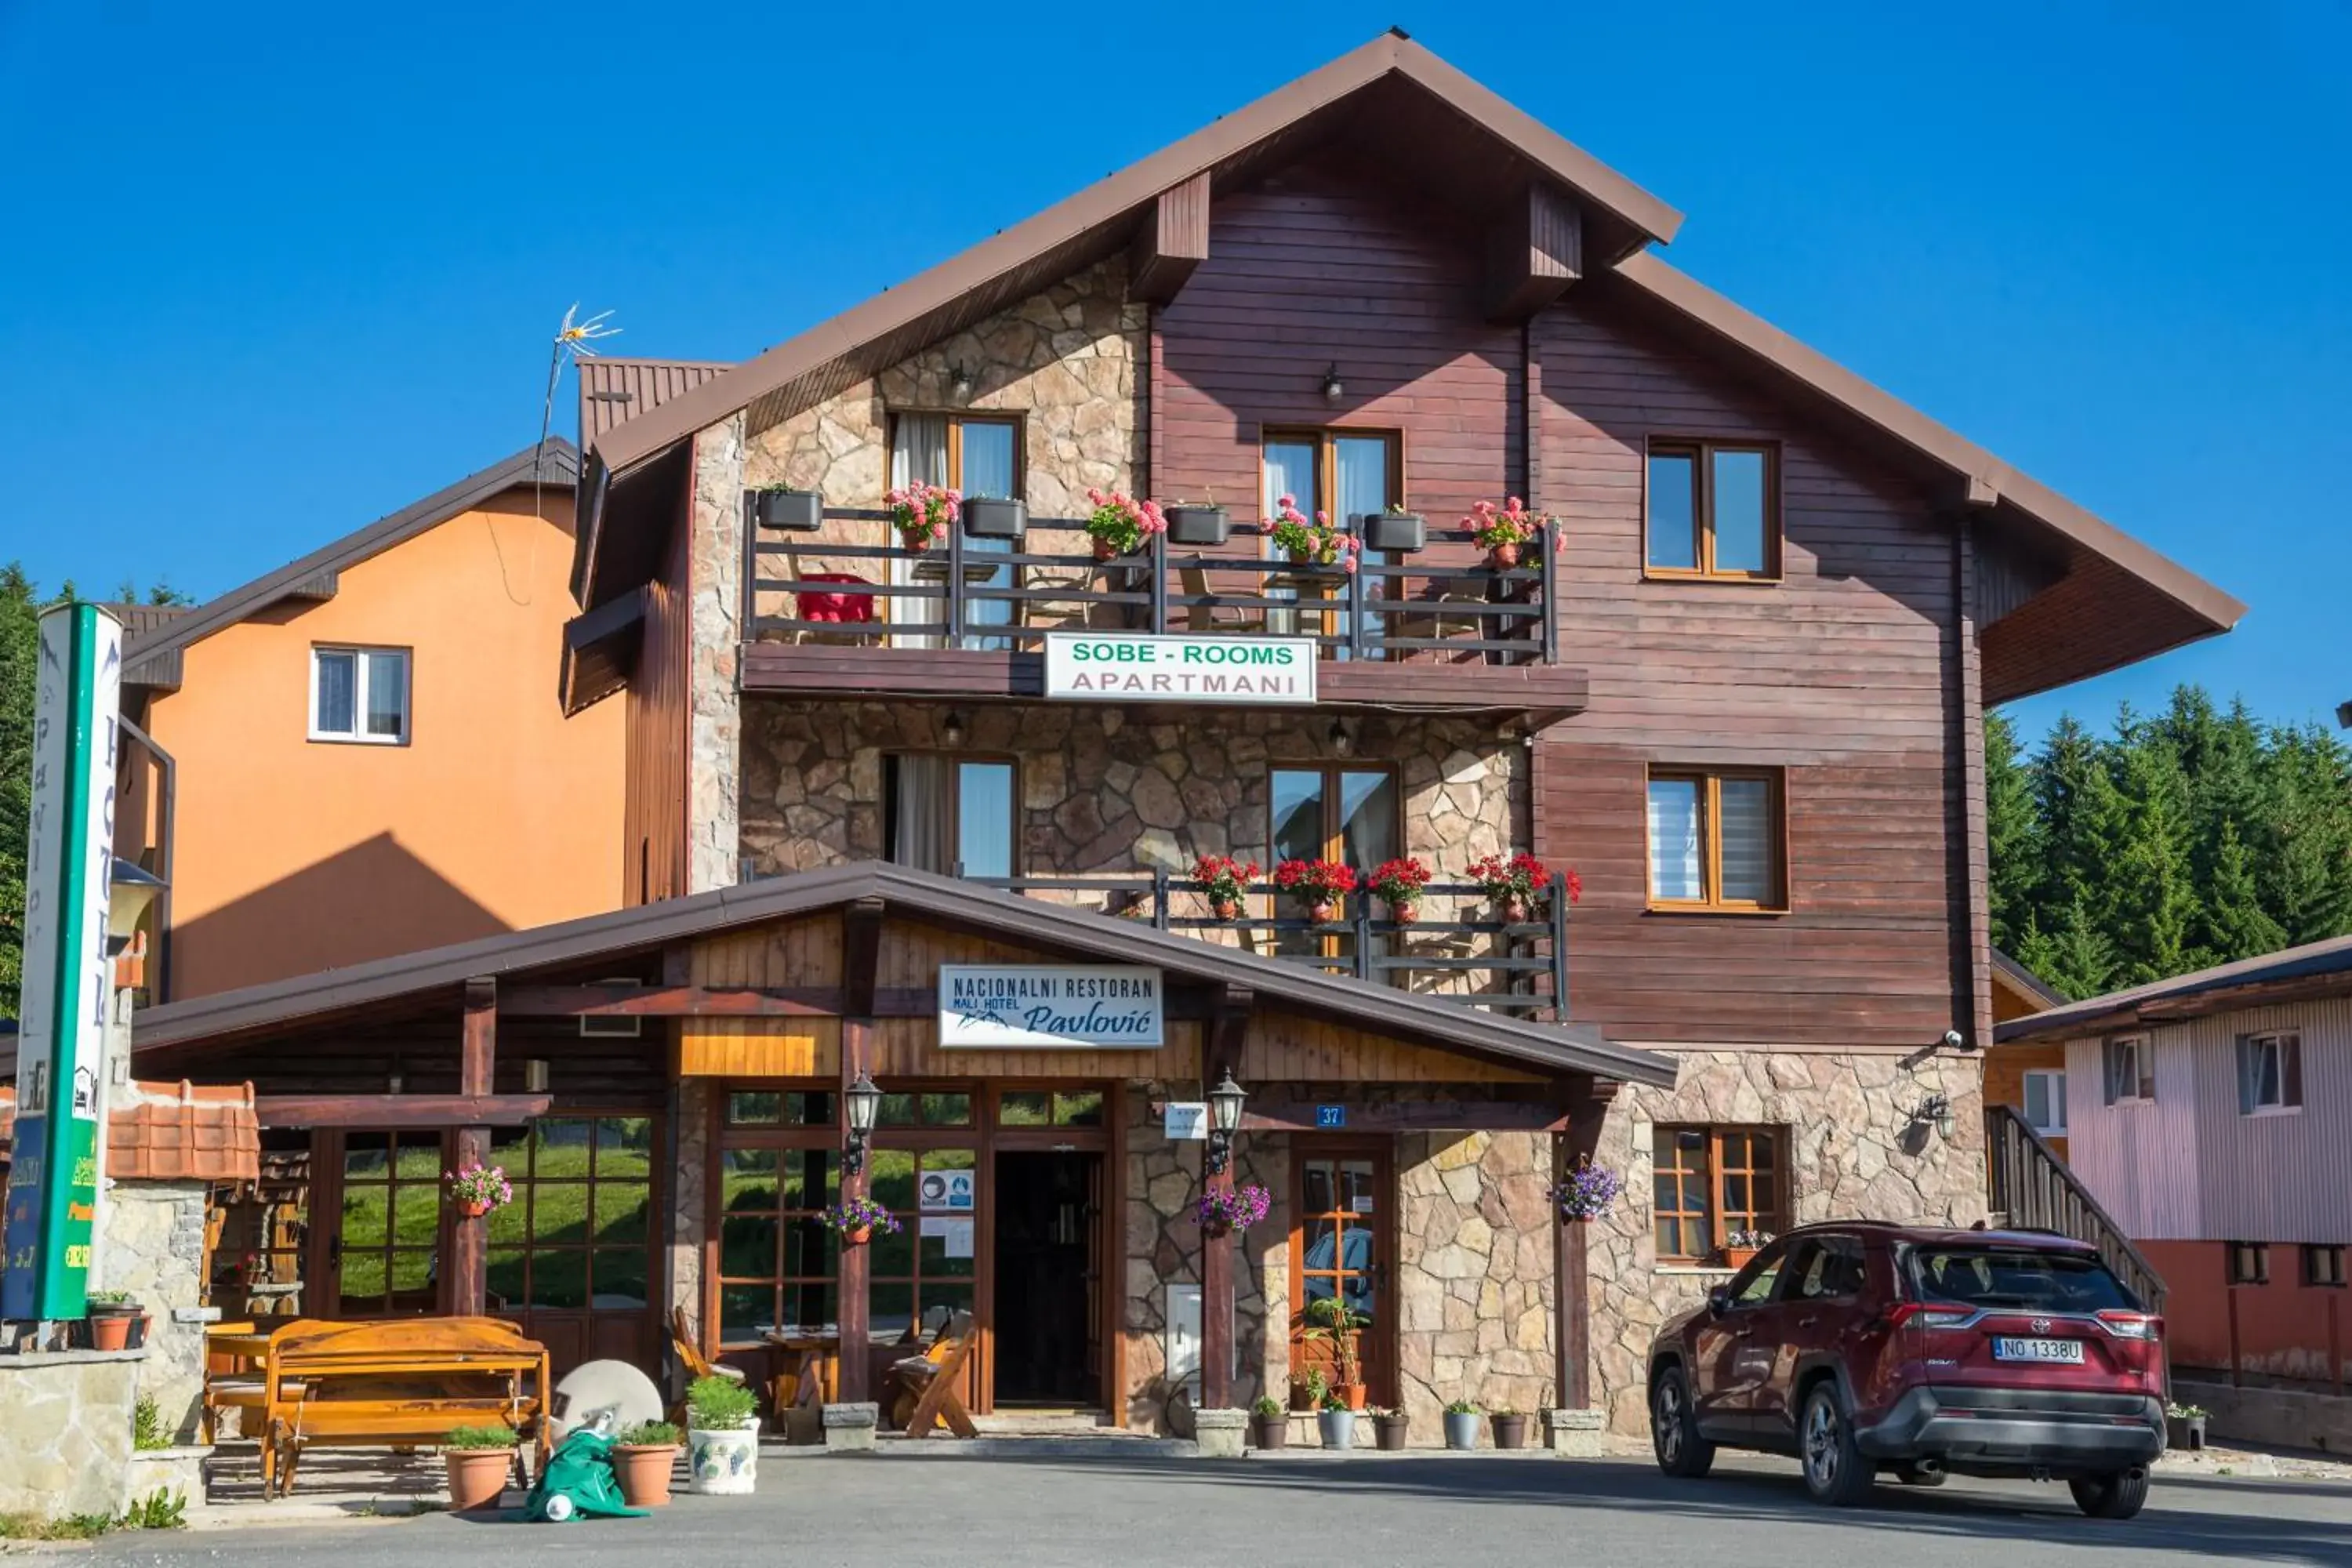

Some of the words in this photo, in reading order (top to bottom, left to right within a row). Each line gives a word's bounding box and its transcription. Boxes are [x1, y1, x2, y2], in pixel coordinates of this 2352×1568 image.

[1072, 642, 1156, 662] SOBE
[1183, 644, 1294, 665] ROOMS
[1071, 672, 1294, 694] APARTMANI
[953, 978, 1057, 998] NACIONALNI
[1066, 978, 1152, 998] RESTORAN
[953, 998, 978, 1009] MALI
[984, 998, 1020, 1009] HOTEL
[1023, 1000, 1152, 1033] Pavlović
[1323, 1108, 1338, 1123] 37
[2031, 1341, 2079, 1358] 1338U
